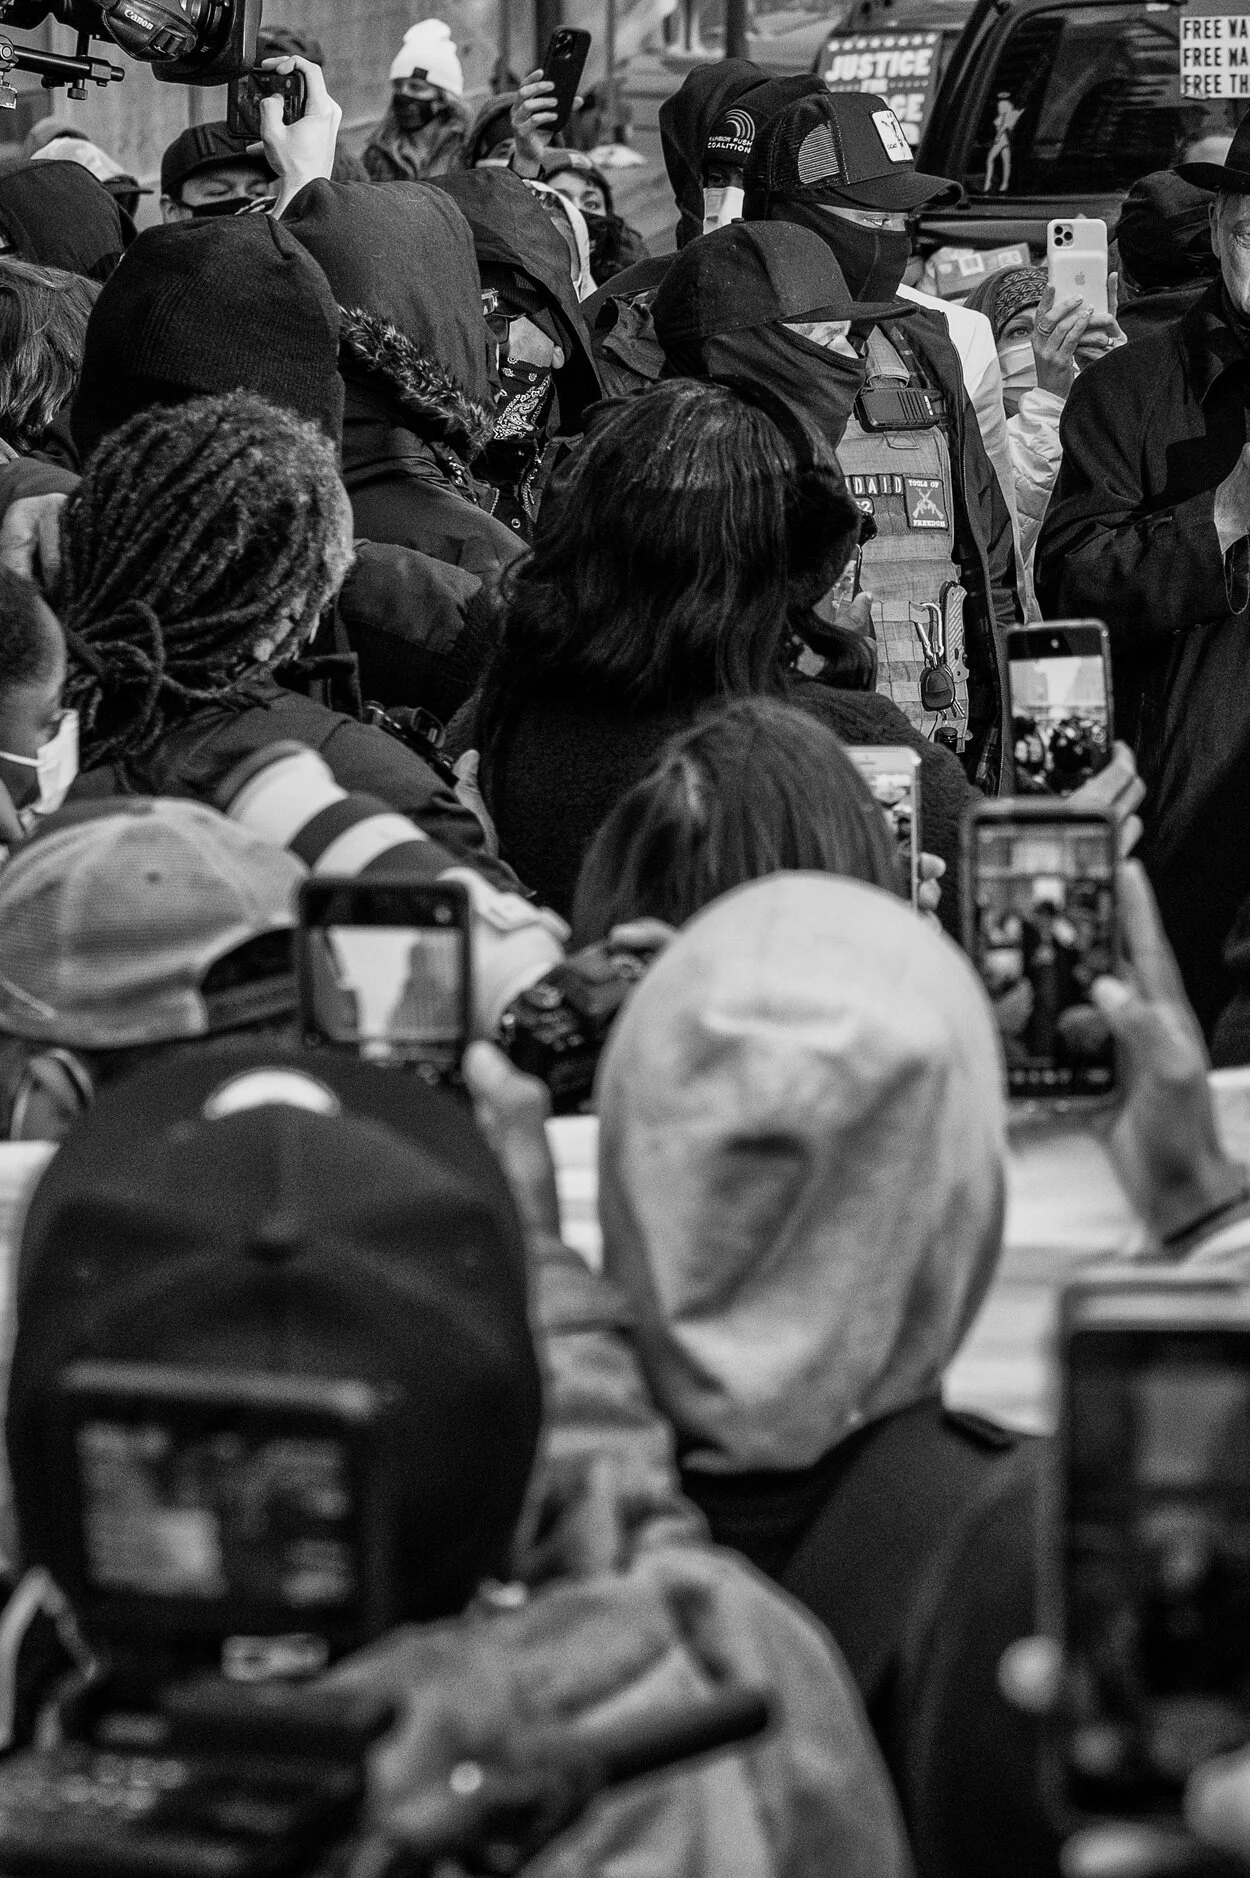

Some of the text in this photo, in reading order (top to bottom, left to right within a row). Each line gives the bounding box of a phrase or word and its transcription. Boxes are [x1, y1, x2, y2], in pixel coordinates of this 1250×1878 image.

[124, 9, 154, 30] Canon
[1183, 19, 1222, 39] FREE
[824, 48, 933, 82] JUSTICE
[1183, 47, 1222, 67] FREE
[1183, 74, 1222, 94] FREE
[707, 141, 752, 154] COALITION
[732, 137, 753, 147] PUSH
